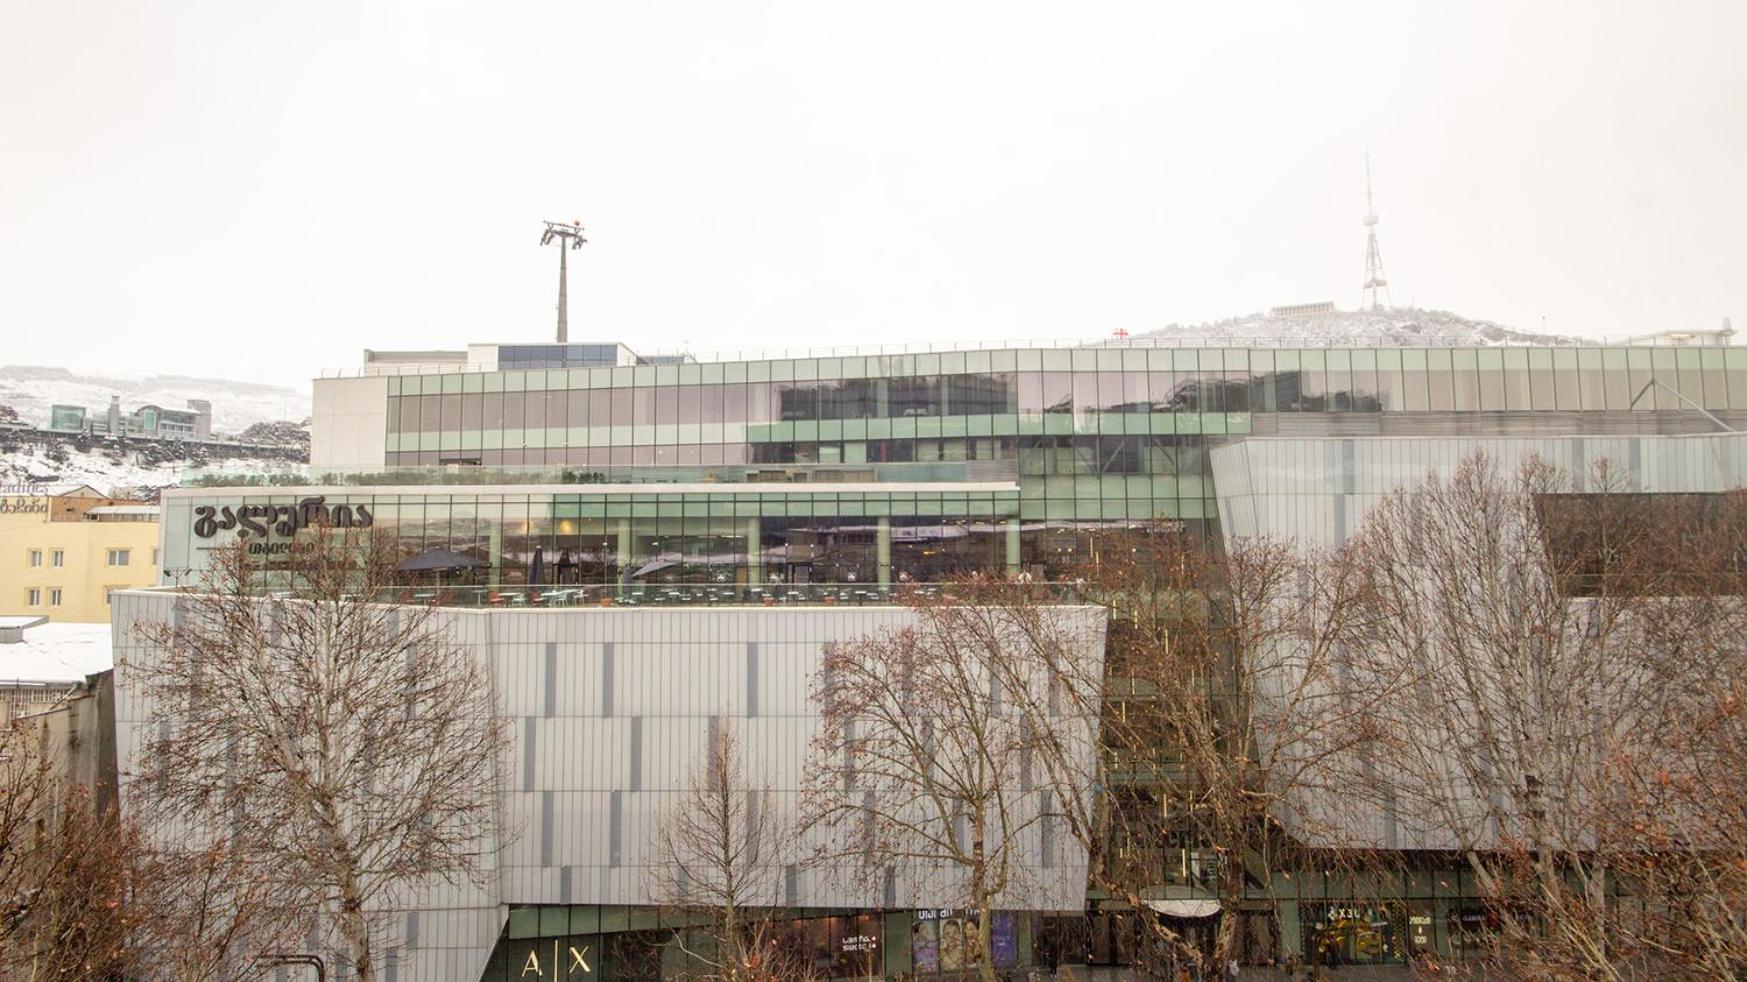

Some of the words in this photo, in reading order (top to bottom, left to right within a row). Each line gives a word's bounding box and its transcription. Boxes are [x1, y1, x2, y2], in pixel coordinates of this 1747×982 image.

[0, 480, 49, 493] adines
[194, 495, 373, 538] გალერია
[248, 542, 316, 555] თბილი
